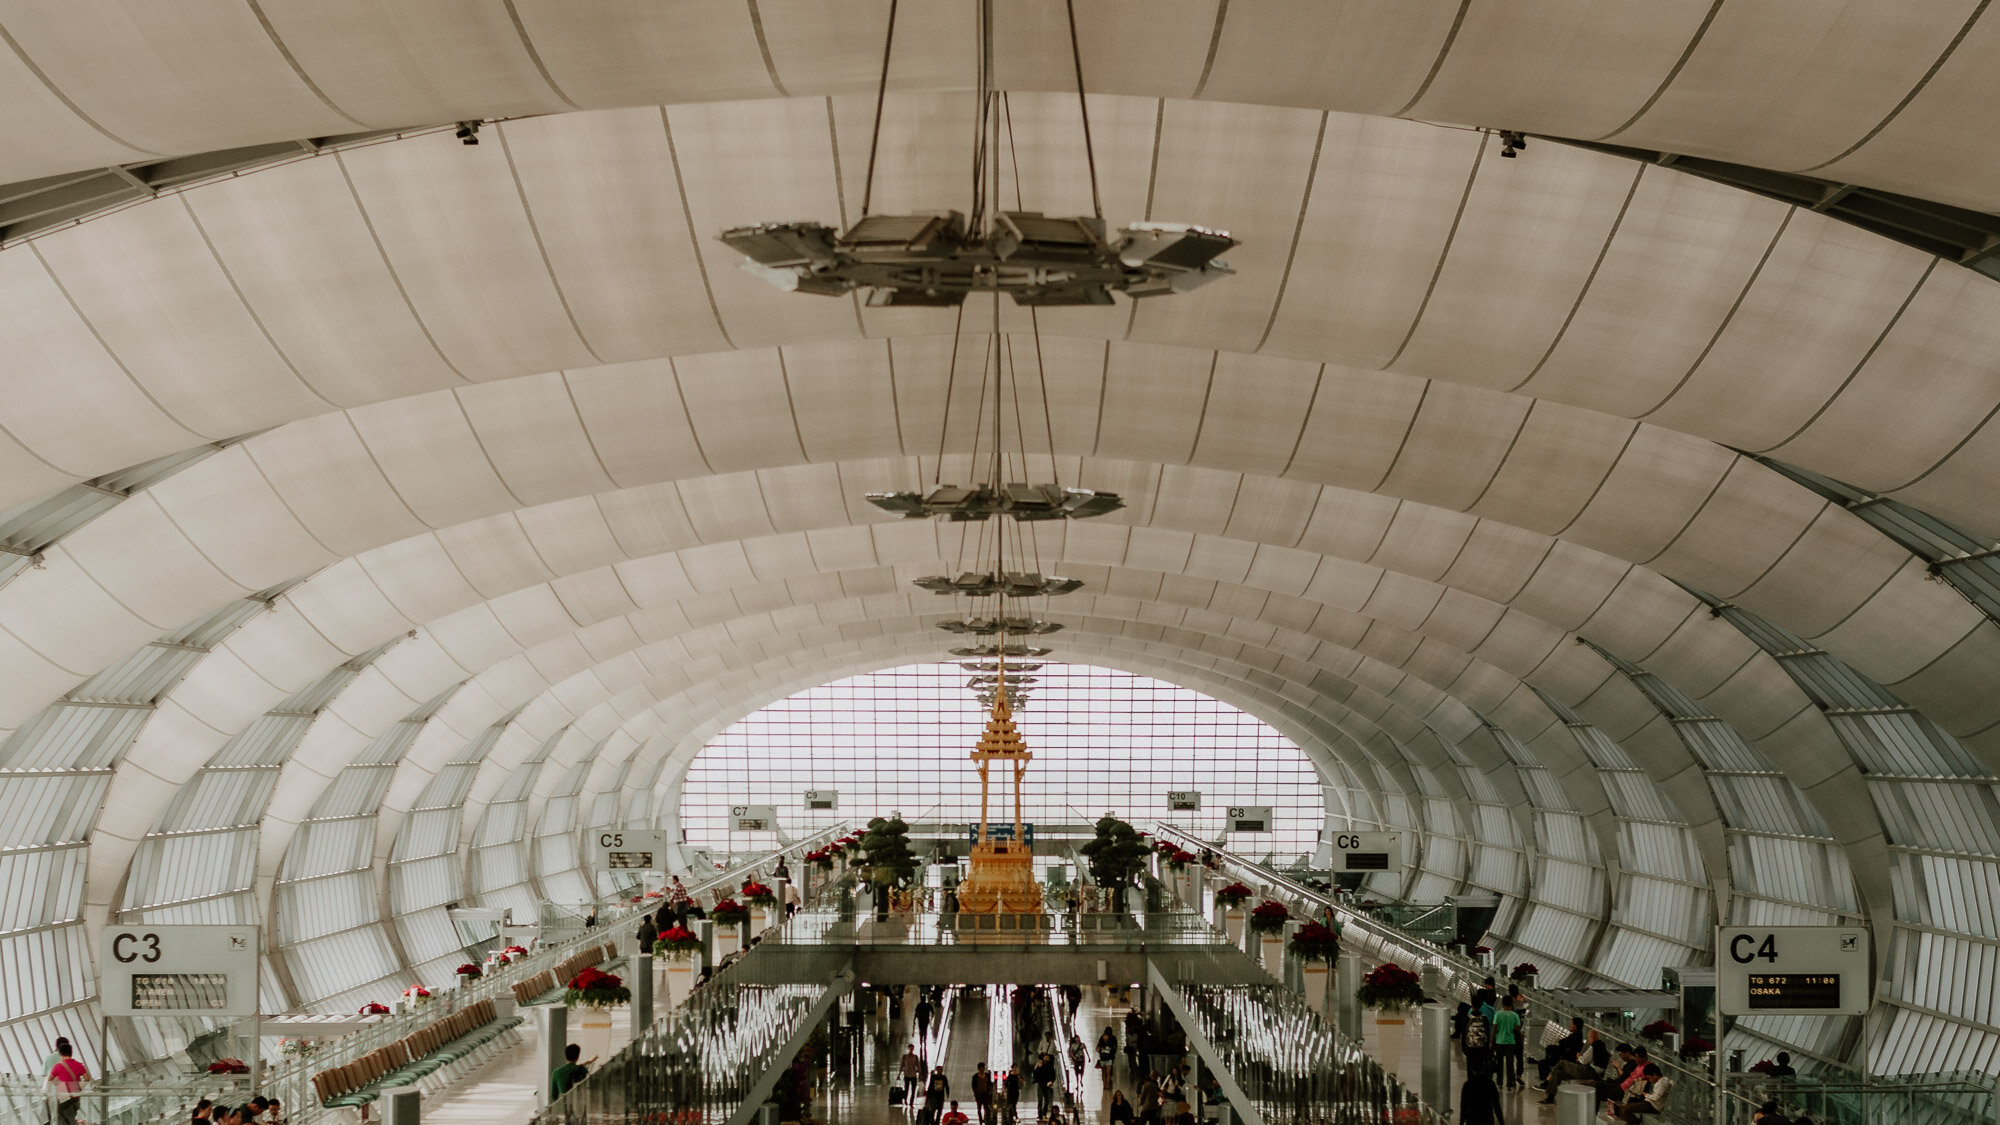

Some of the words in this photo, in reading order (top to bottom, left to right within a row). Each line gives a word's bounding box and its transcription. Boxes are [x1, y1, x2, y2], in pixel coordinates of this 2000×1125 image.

[806, 791, 818, 800] C9
[733, 807, 748, 816] C7
[1229, 808, 1245, 818] C8
[600, 834, 623, 848] C5
[1337, 835, 1360, 849] C6
[113, 933, 161, 963] C3
[1730, 934, 1778, 964] C4
[1805, 977, 1835, 985] 11:00
